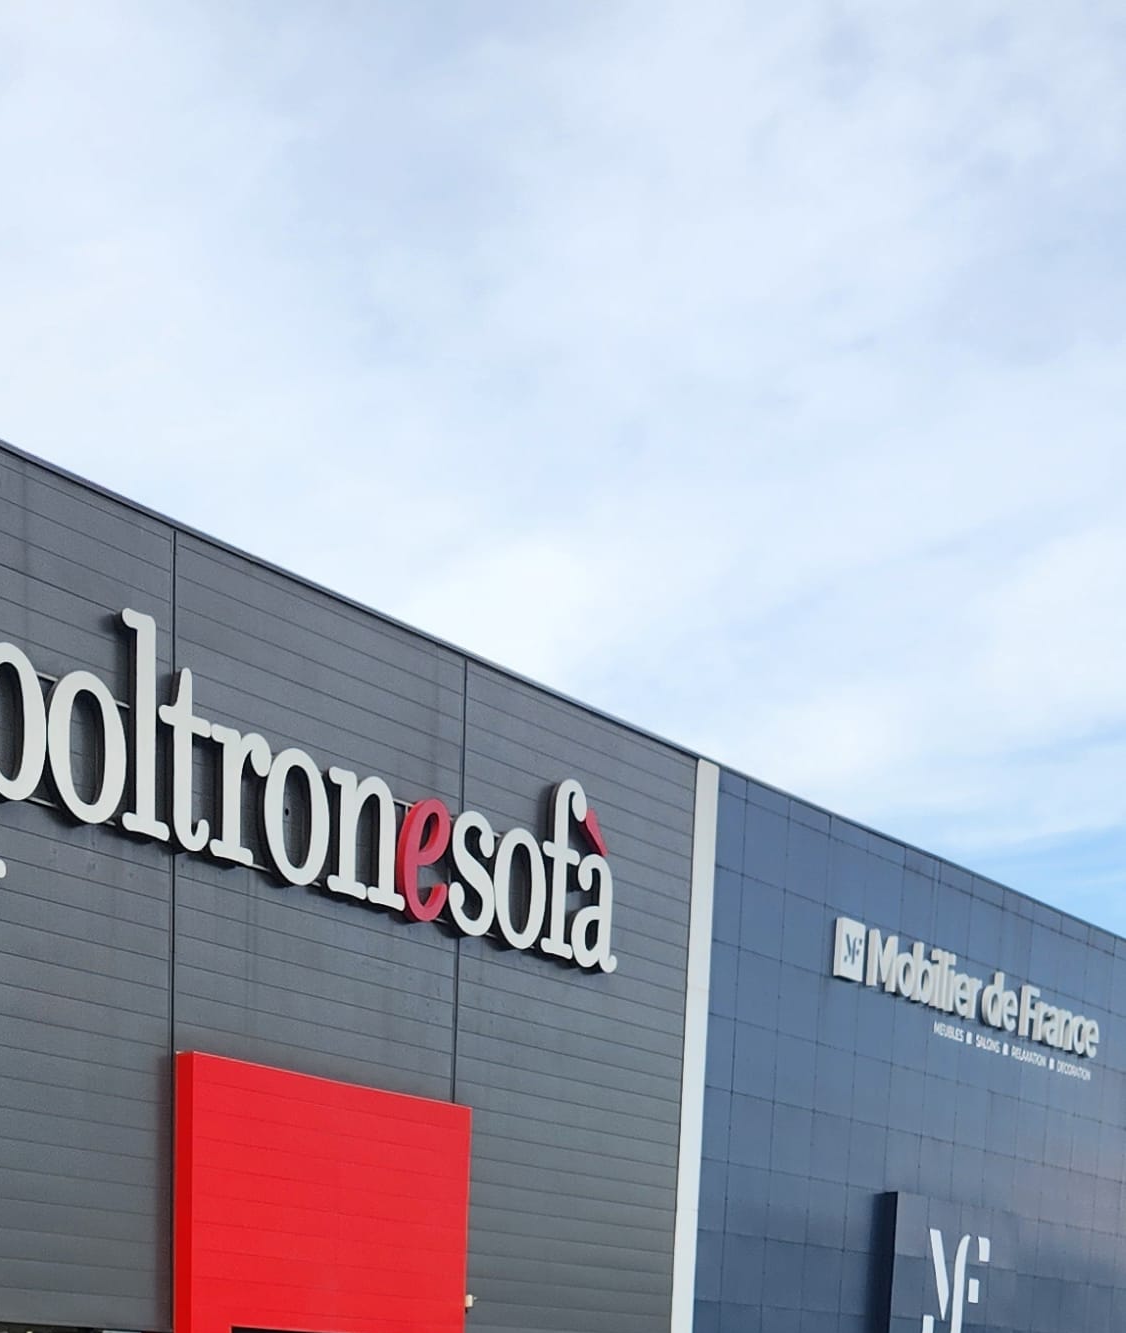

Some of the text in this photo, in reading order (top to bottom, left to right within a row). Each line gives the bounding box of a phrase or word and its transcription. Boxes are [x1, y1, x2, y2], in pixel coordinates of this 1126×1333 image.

[866, 928, 1100, 1058] Mobilier de France
[933, 1020, 965, 1042] MEUBLES
[975, 1033, 1001, 1053] SALONS
